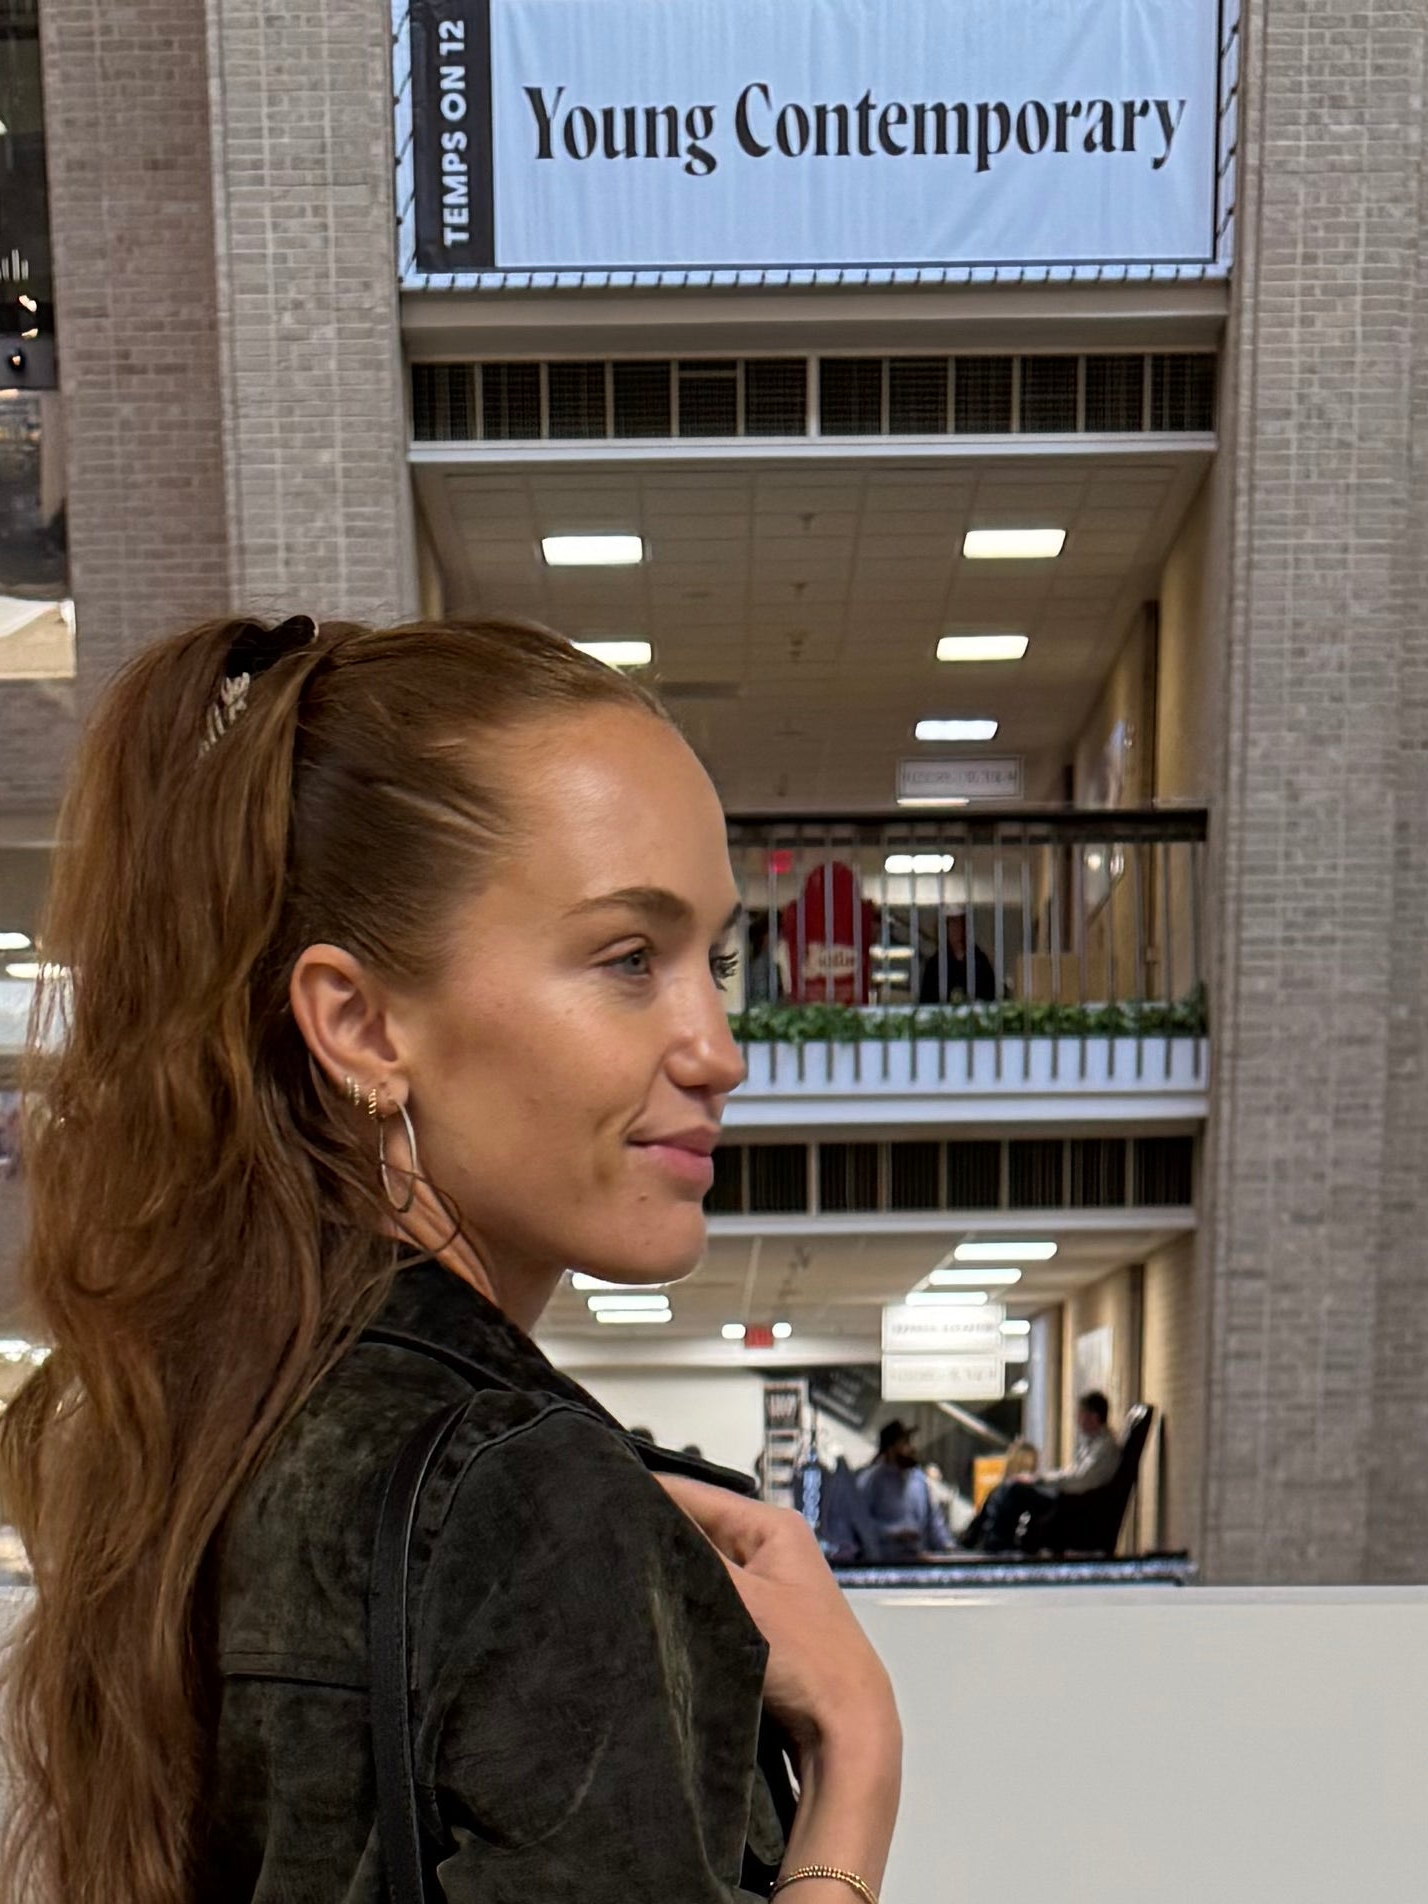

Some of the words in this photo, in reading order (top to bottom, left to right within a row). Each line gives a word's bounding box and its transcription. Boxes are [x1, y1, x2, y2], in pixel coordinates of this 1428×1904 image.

[438, 20, 465, 56] 12
[439, 66, 467, 121] ON
[523, 84, 715, 175] Young
[734, 83, 1187, 170] Contemporary
[441, 131, 470, 247] TEMPS
